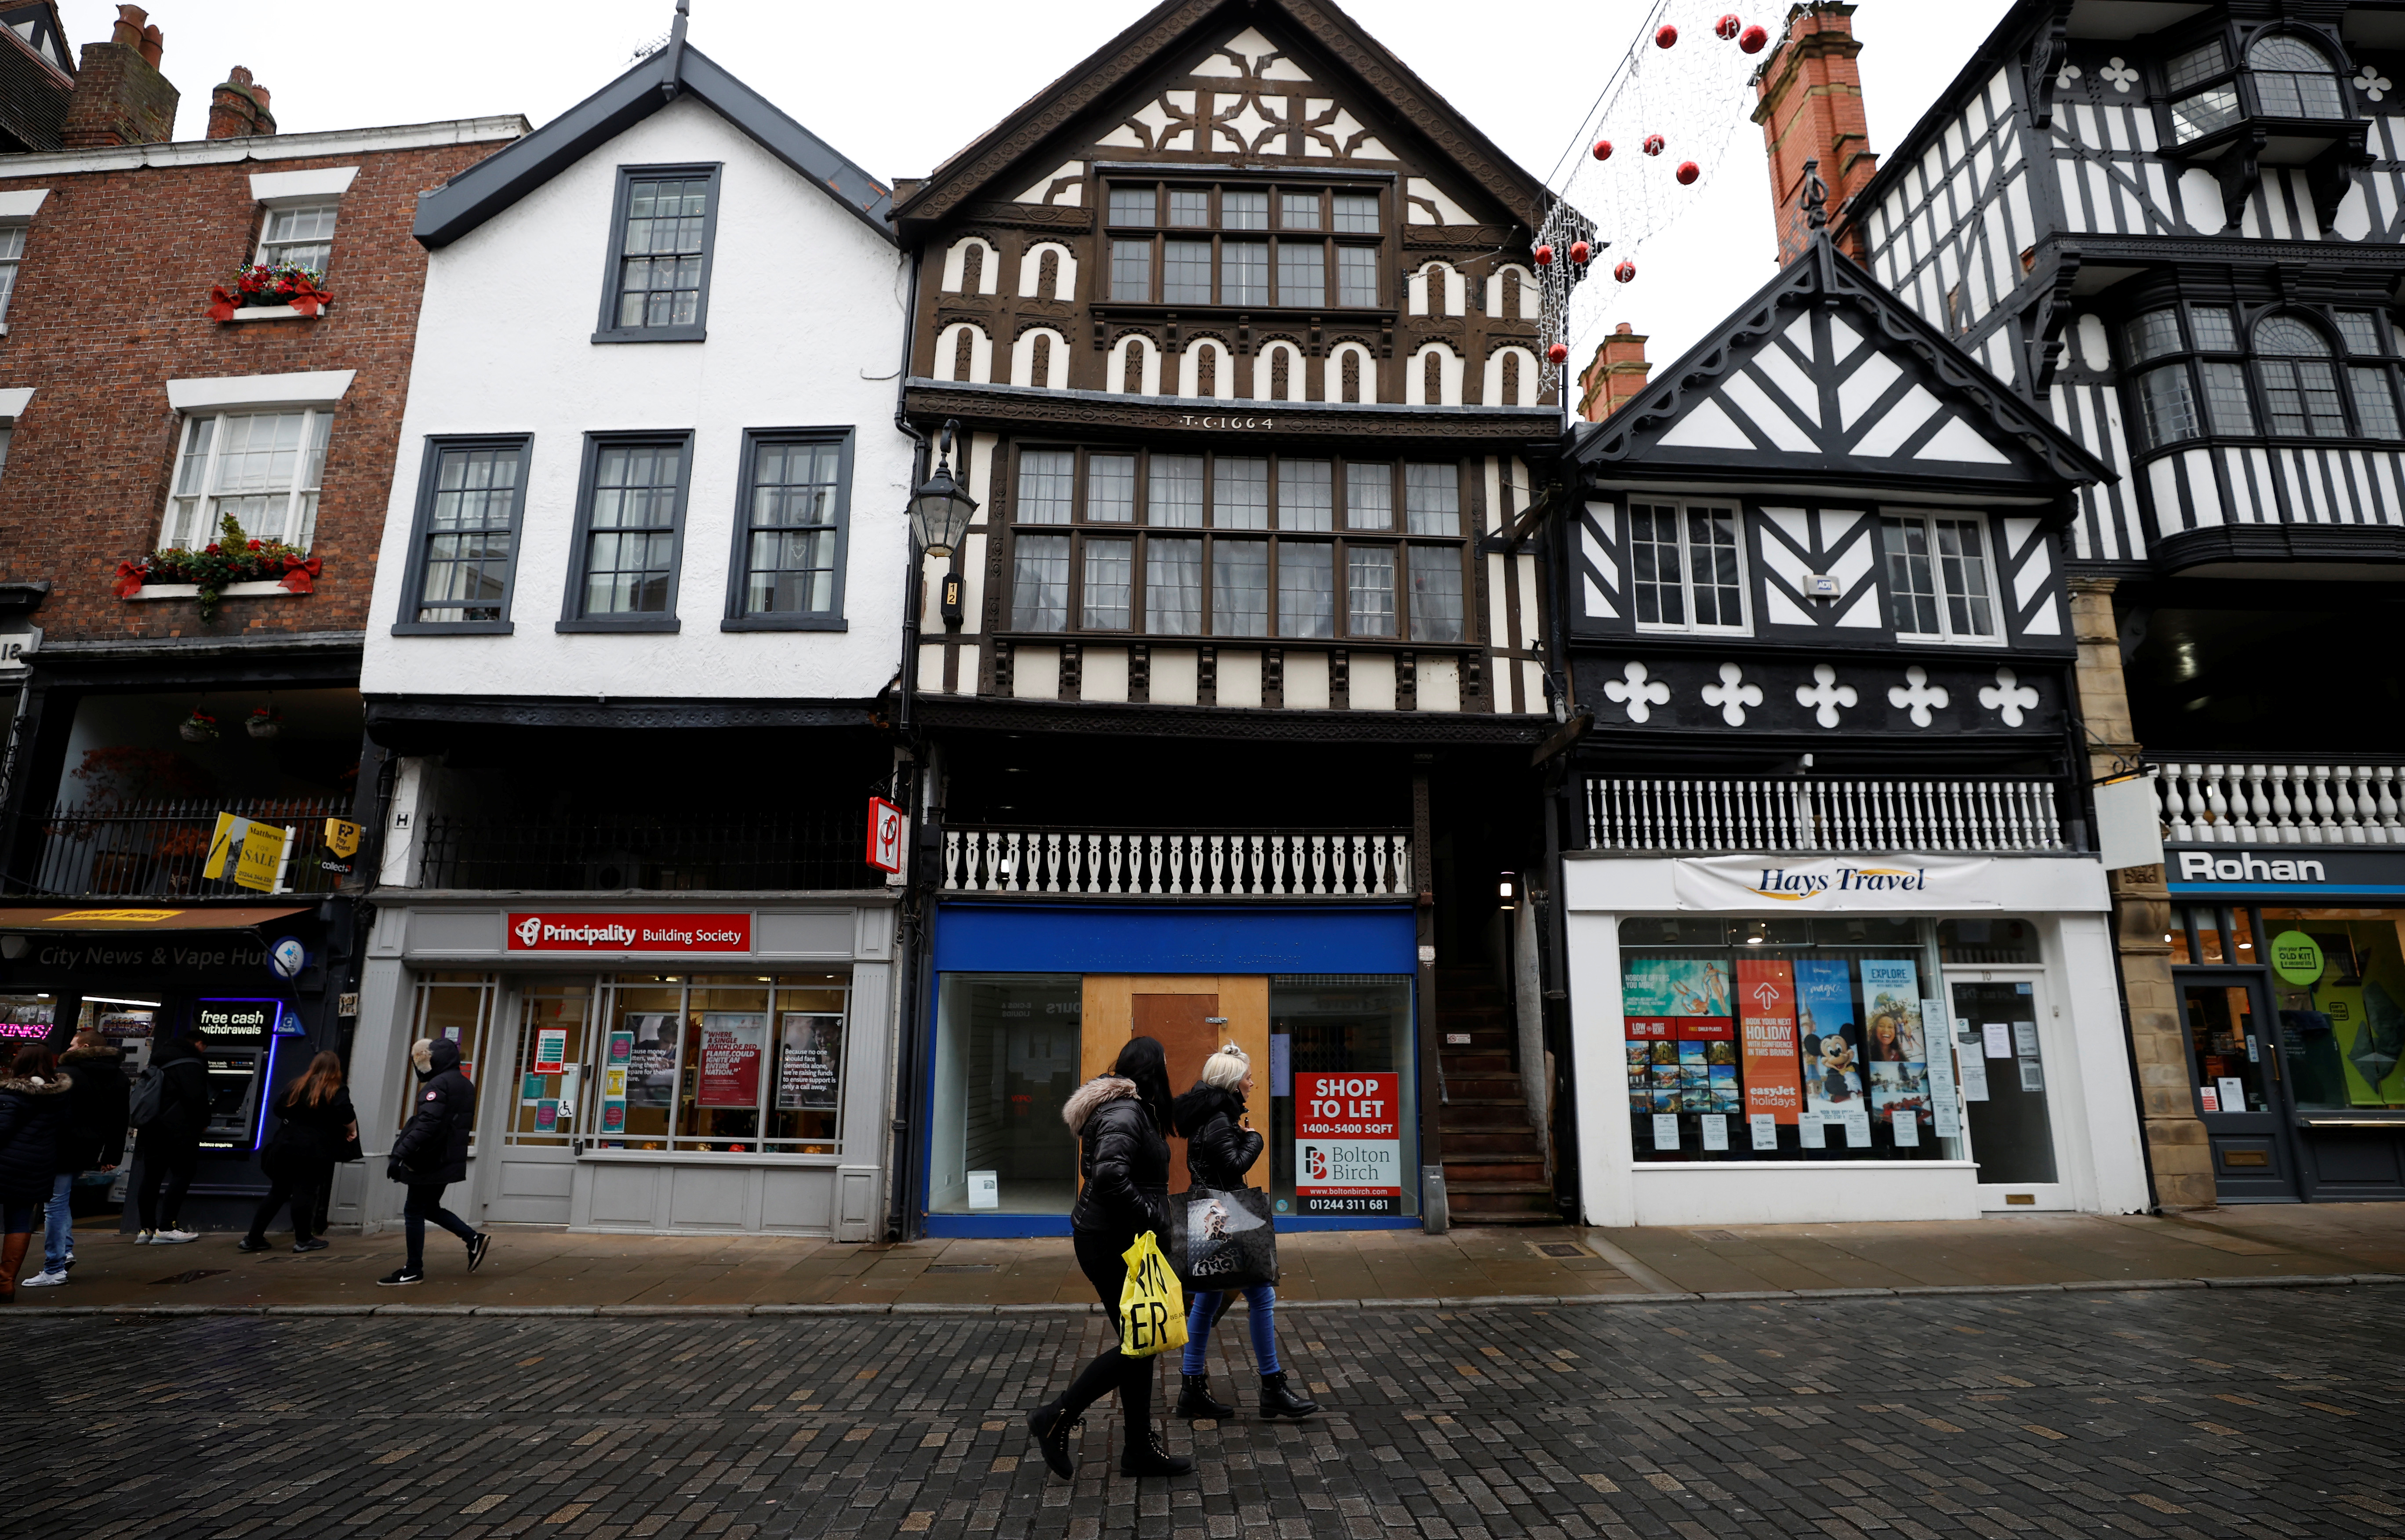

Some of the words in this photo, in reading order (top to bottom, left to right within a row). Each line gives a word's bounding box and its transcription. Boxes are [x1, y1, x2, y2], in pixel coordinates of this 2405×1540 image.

[1, 643, 22, 660] 18
[396, 814, 408, 826] H
[249, 827, 282, 842] Matthews
[337, 836, 346, 846] Pay
[335, 843, 350, 852] Point
[243, 849, 276, 868] SALE
[2178, 851, 2325, 881] Rohan
[1758, 868, 1829, 897] Hays
[1836, 868, 1926, 891] Travel
[544, 924, 636, 946] Principality
[643, 929, 693, 944] Building
[696, 929, 742, 945] Society
[40, 948, 82, 970] City
[86, 948, 142, 965] News
[152, 948, 167, 965] &
[174, 948, 225, 970] Vape
[231, 948, 268, 965] Hut
[1871, 969, 1907, 979] EXPLORE
[1981, 971, 1991, 981] 10
[201, 1010, 228, 1024] free
[231, 1011, 264, 1024] cash
[199, 1024, 262, 1035] withdrawals
[1746, 1026, 1791, 1040] HOLIDAY
[1316, 1079, 1379, 1097] SHOP
[1750, 1085, 1796, 1097] easyJet
[1310, 1100, 1341, 1118] TO
[1348, 1101, 1384, 1118] LET
[1751, 1096, 1796, 1108] holidays
[1302, 1124, 1362, 1133] 1400-5400
[1365, 1124, 1393, 1134] SQFT
[1332, 1147, 1390, 1162] Bolton
[1333, 1164, 1379, 1180] Birch
[1310, 1199, 1344, 1209] 01244
[1346, 1199, 1365, 1209] 311
[1369, 1199, 1388, 1209] 681
[1130, 1302, 1167, 1350] ER
